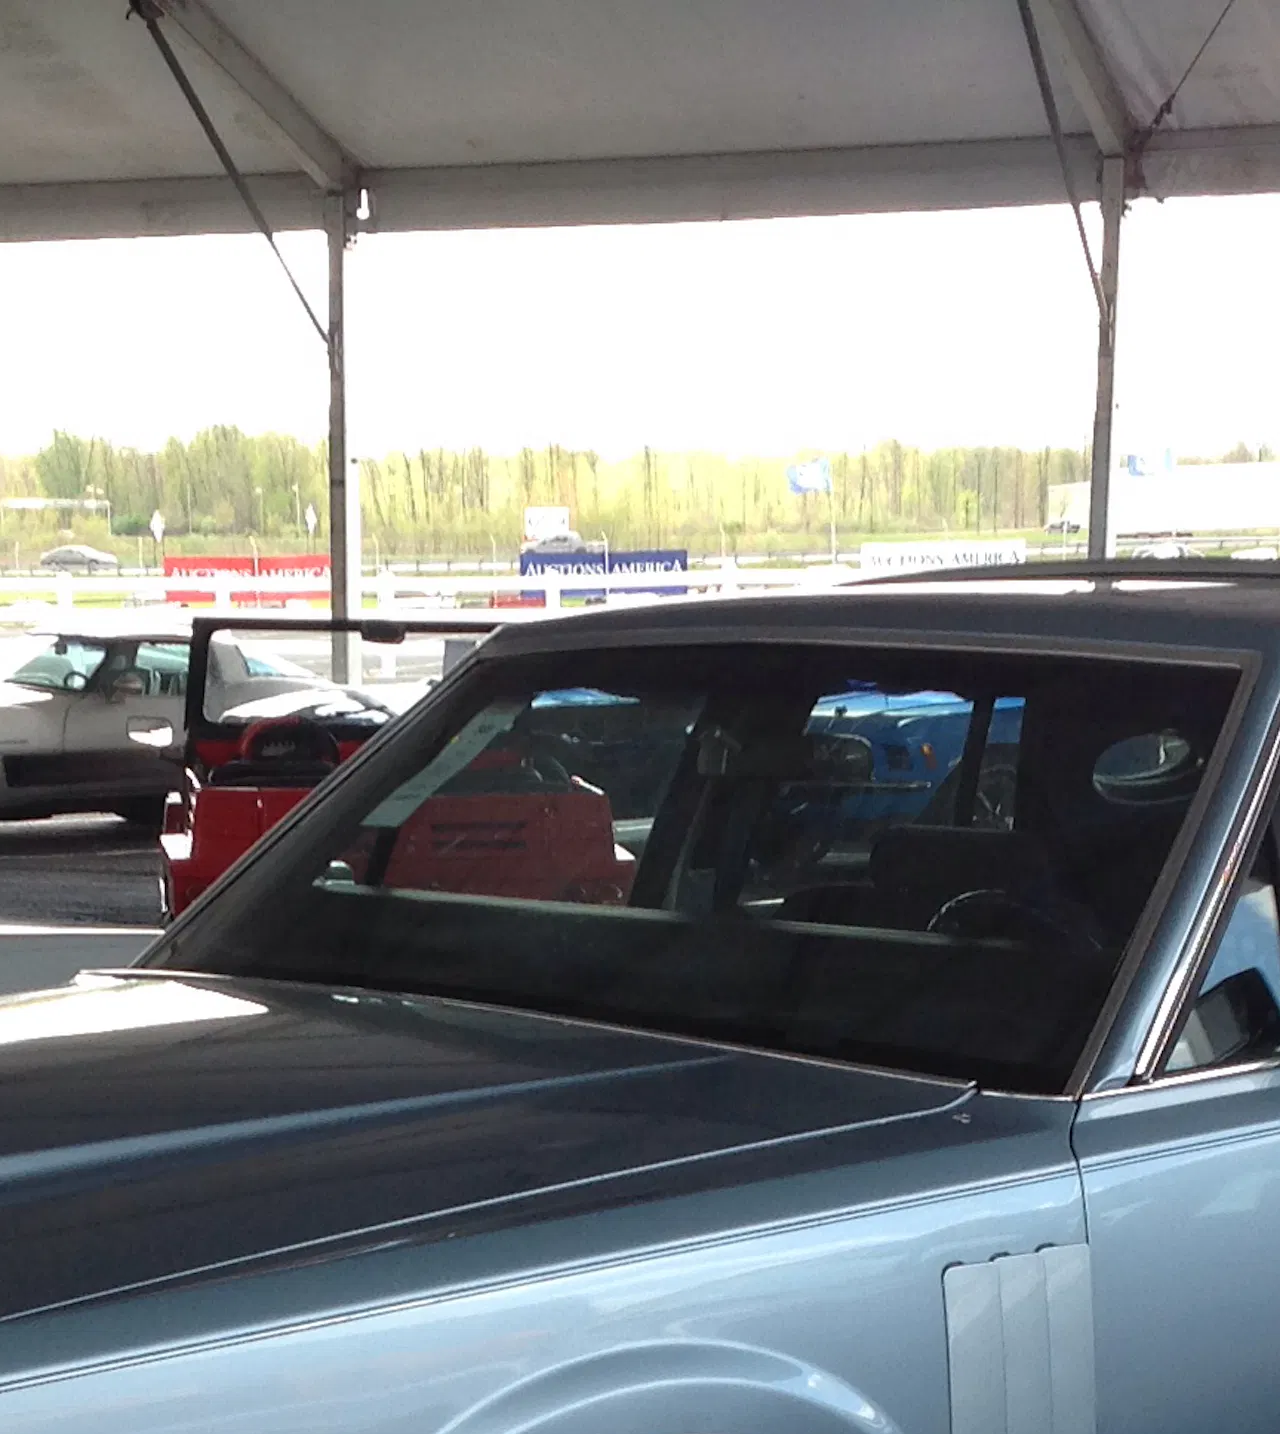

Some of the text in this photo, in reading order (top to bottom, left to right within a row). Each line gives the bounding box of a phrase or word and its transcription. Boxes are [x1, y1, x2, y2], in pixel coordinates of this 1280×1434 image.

[952, 550, 1021, 566] AMERICA
[525, 559, 683, 577] AUCTIONS AMERICA
